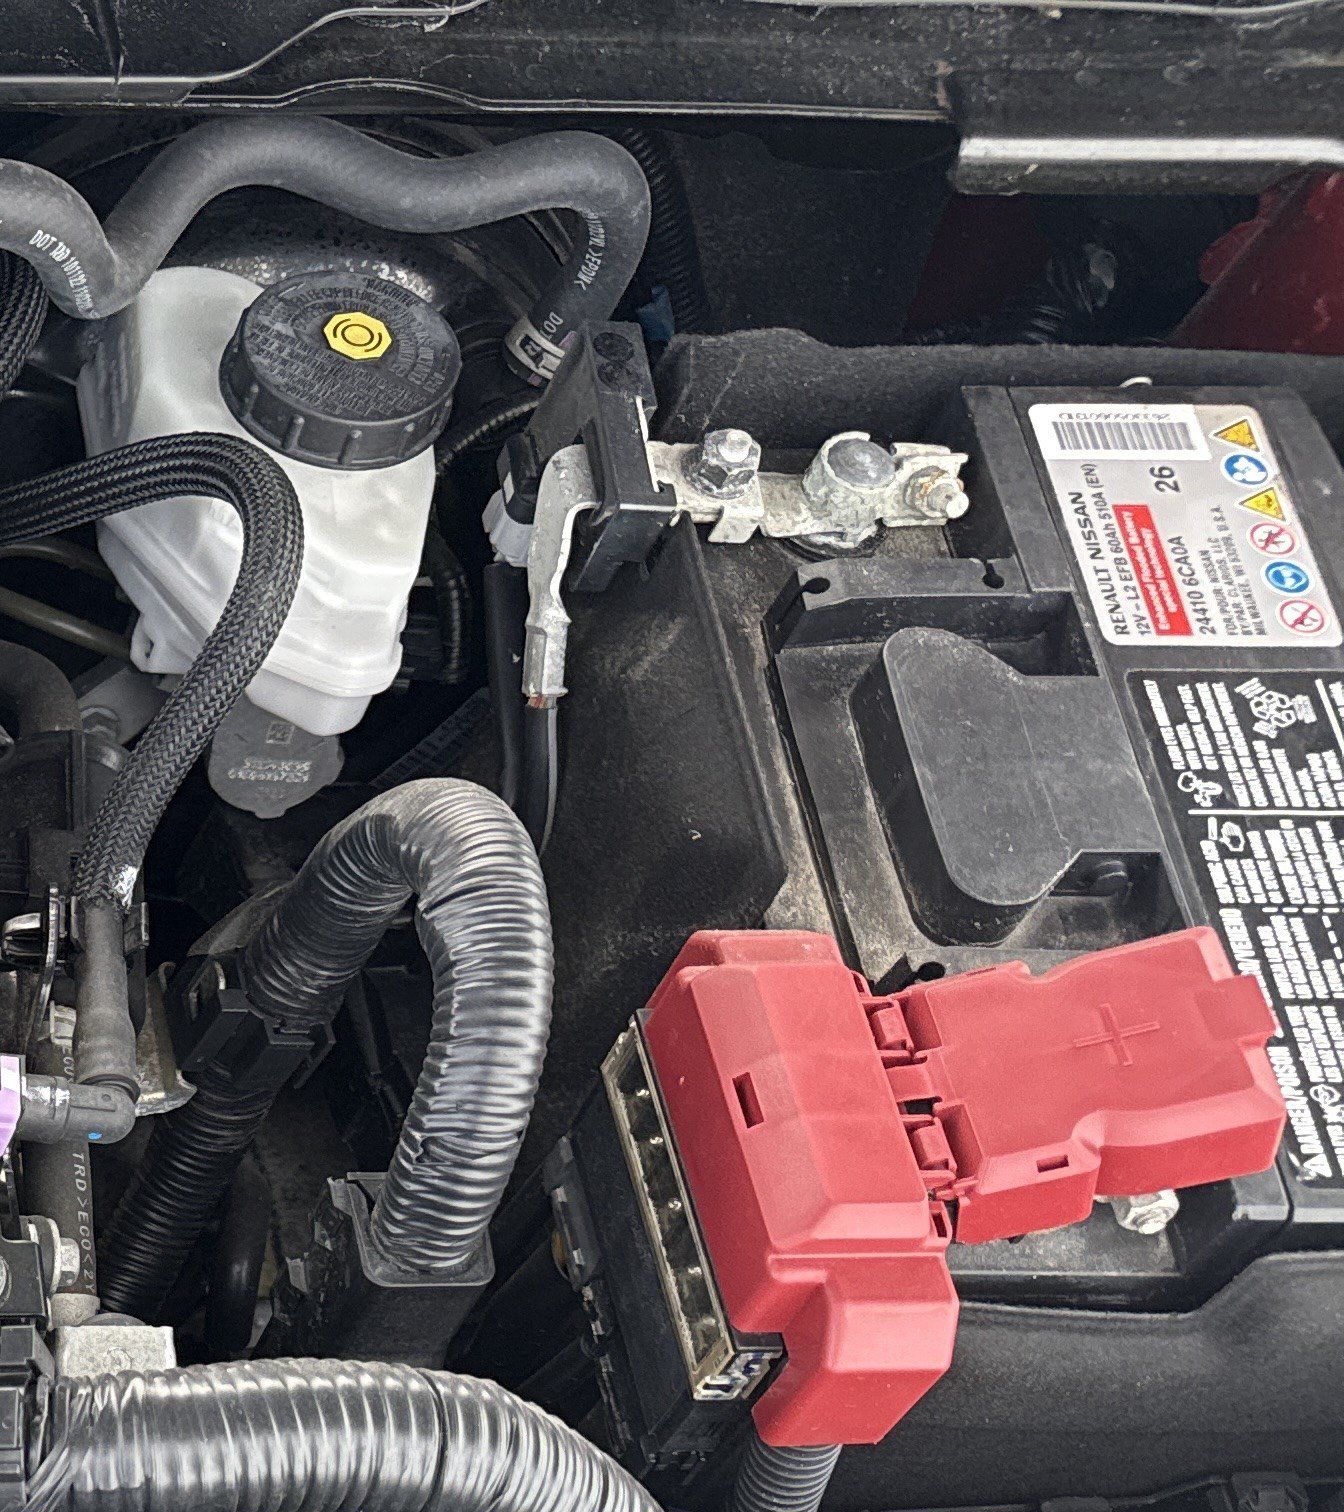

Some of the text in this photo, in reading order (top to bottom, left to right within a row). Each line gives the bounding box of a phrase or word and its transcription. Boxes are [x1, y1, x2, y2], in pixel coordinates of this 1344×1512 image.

[28, 229, 58, 251] DOT
[1078, 462, 1104, 488] (EN)
[1147, 465, 1181, 492] 26
[1089, 491, 1112, 519] 510A
[1101, 523, 1124, 553] 60Ah
[1066, 491, 1131, 635] RENAULT NISSAN
[1112, 556, 1133, 581] EFB
[1122, 584, 1140, 599] L2
[1165, 535, 1217, 634] 24410 6CA0A
[1132, 613, 1152, 635] 12V
[1264, 1045, 1326, 1154] DANGER/POISON
